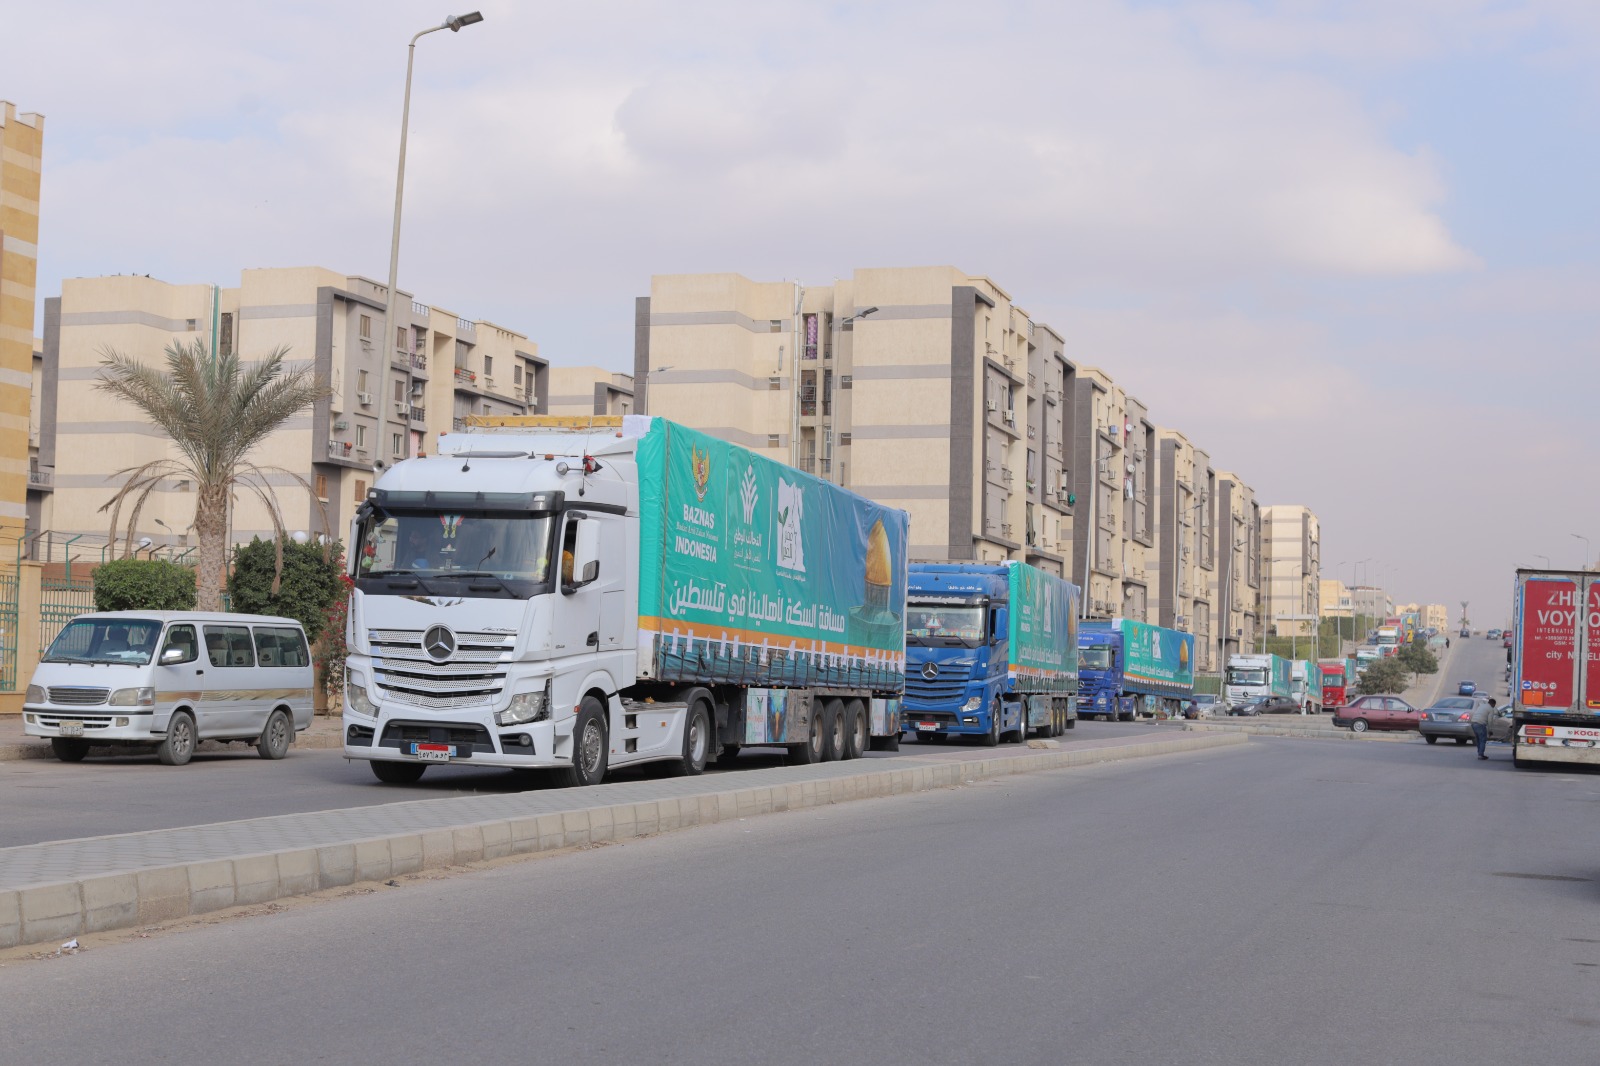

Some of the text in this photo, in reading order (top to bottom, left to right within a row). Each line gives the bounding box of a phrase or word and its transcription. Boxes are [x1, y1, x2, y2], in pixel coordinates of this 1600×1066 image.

[684, 504, 715, 530] BAZNAS
[675, 535, 717, 563] INDONESIA
[669, 578, 845, 633] مسافة السكة لأهالينا في فلسطين
[1546, 650, 1563, 661] city
